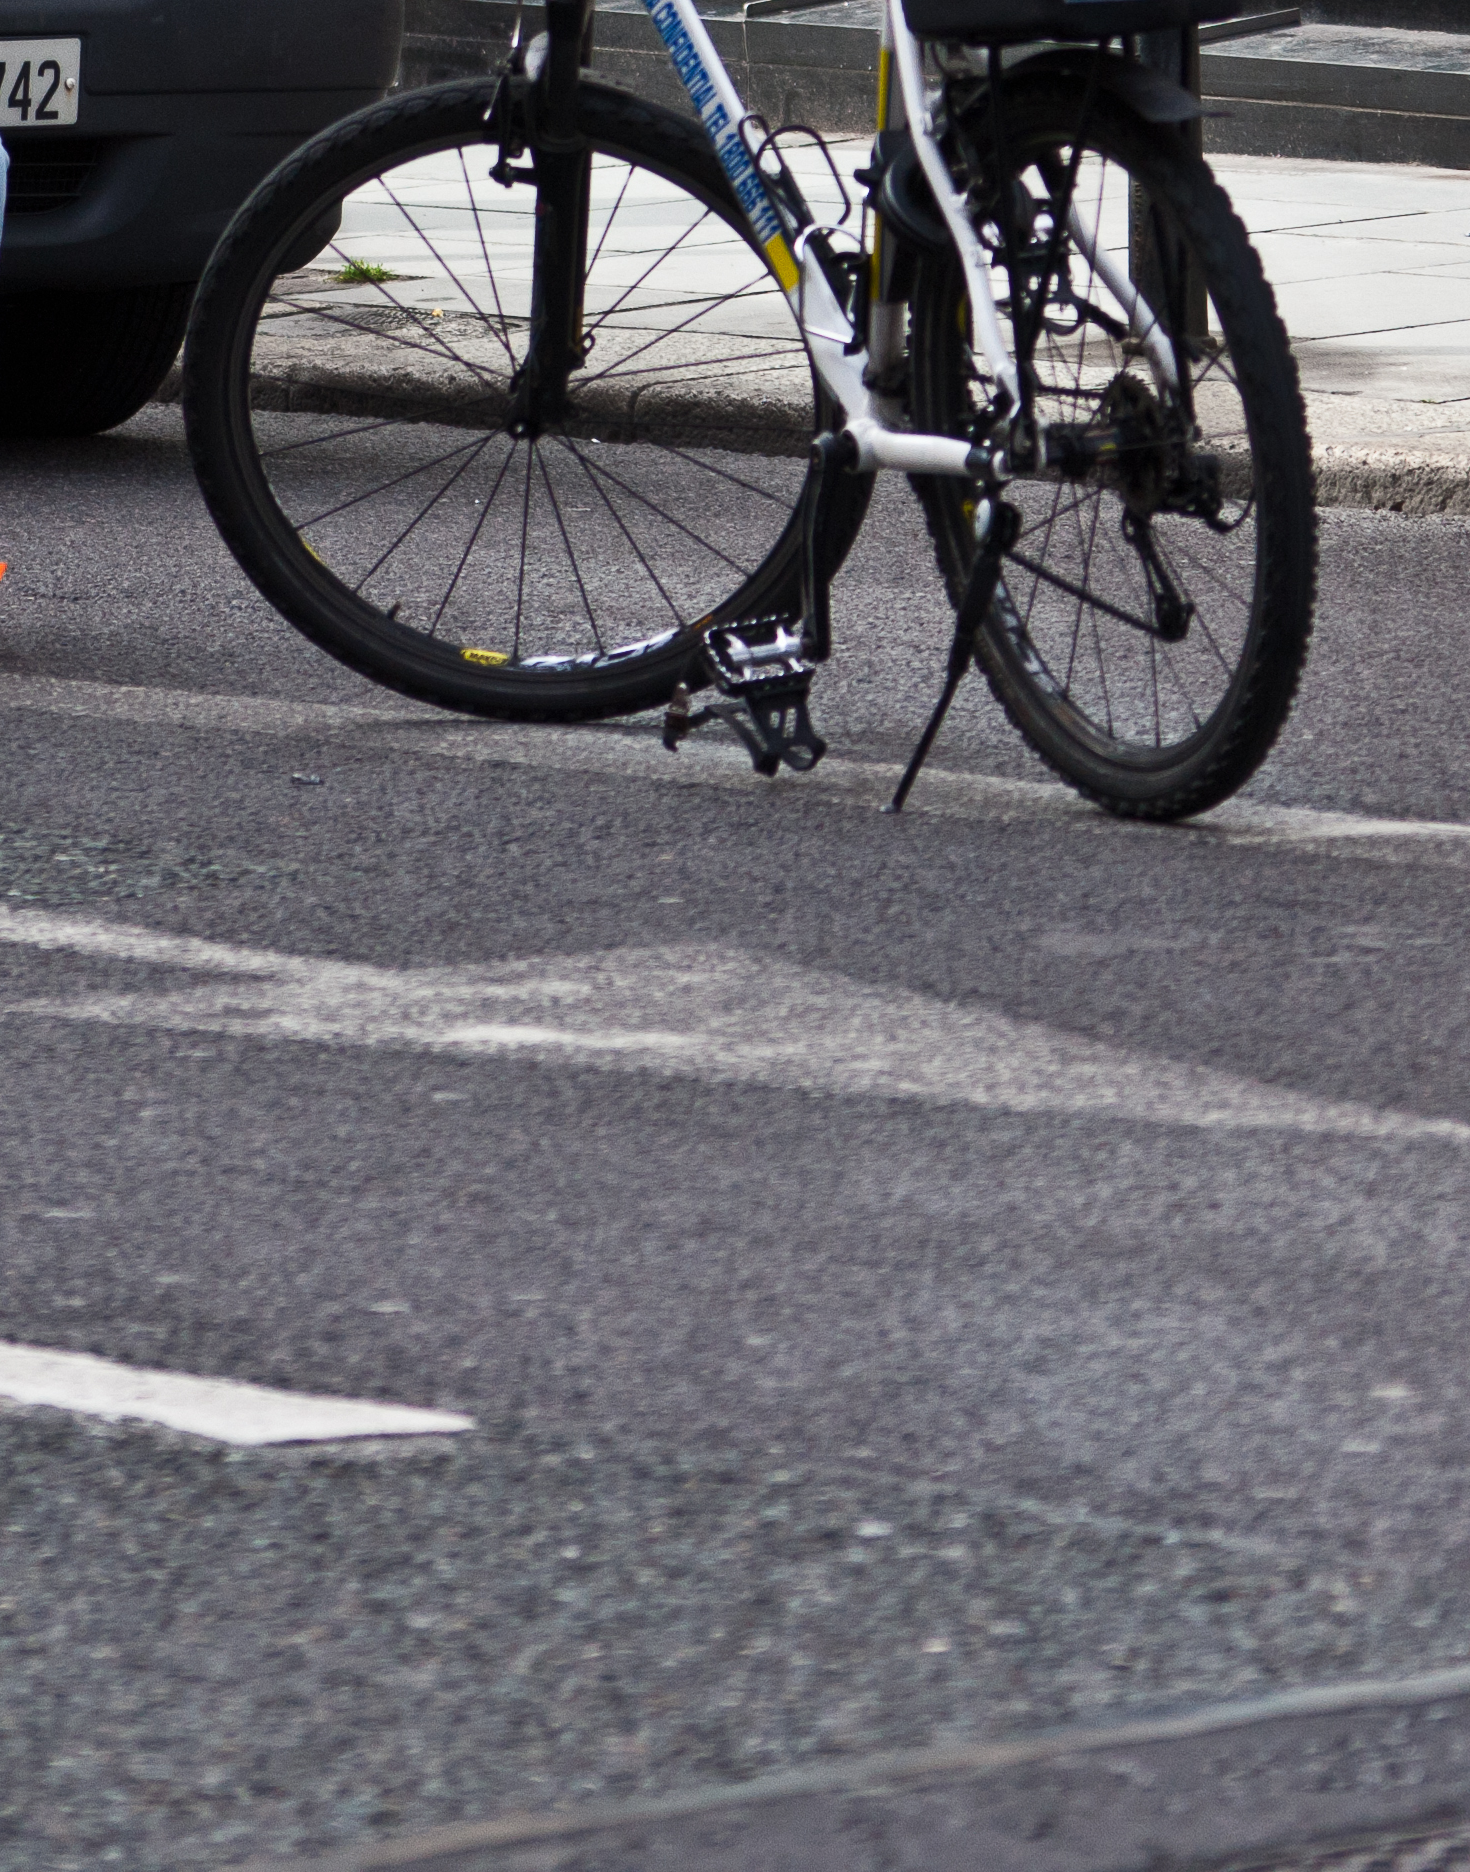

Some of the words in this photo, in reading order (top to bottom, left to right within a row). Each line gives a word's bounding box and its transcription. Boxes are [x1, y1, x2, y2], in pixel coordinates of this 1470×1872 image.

[651, 0, 718, 116] CONFIDENTIAL
[704, 103, 731, 144] TEL
[716, 131, 754, 183] 1800
[735, 170, 770, 214] 666
[752, 206, 782, 245] 111
